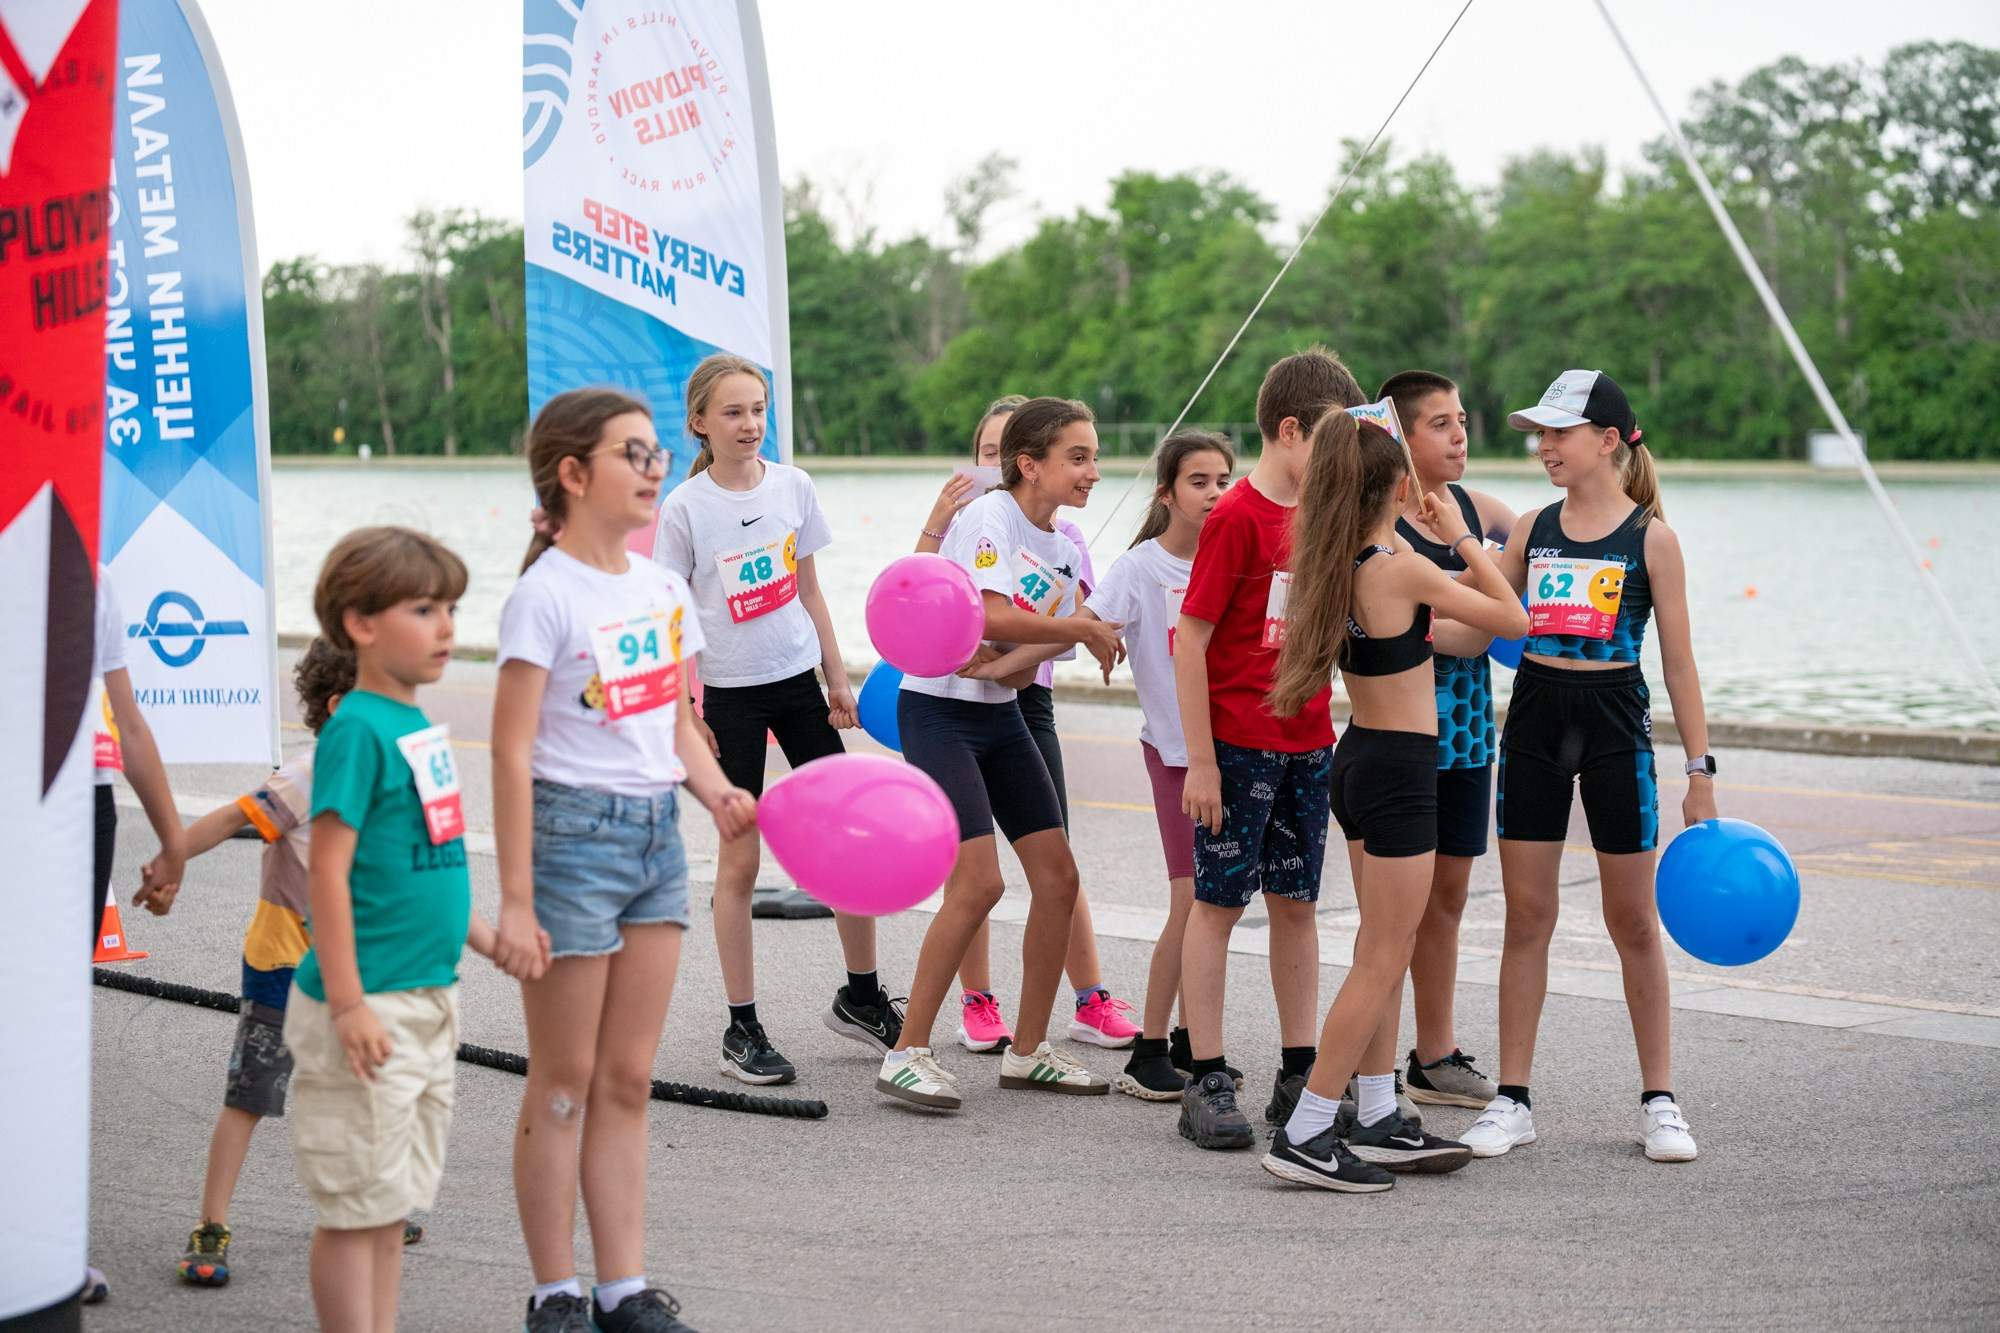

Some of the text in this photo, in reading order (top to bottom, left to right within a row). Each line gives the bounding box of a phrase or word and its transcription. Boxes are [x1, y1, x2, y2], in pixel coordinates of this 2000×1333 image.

[739, 556, 773, 585] 48
[1019, 572, 1051, 602] 47
[1538, 572, 1574, 600] 62
[617, 628, 659, 666] 94
